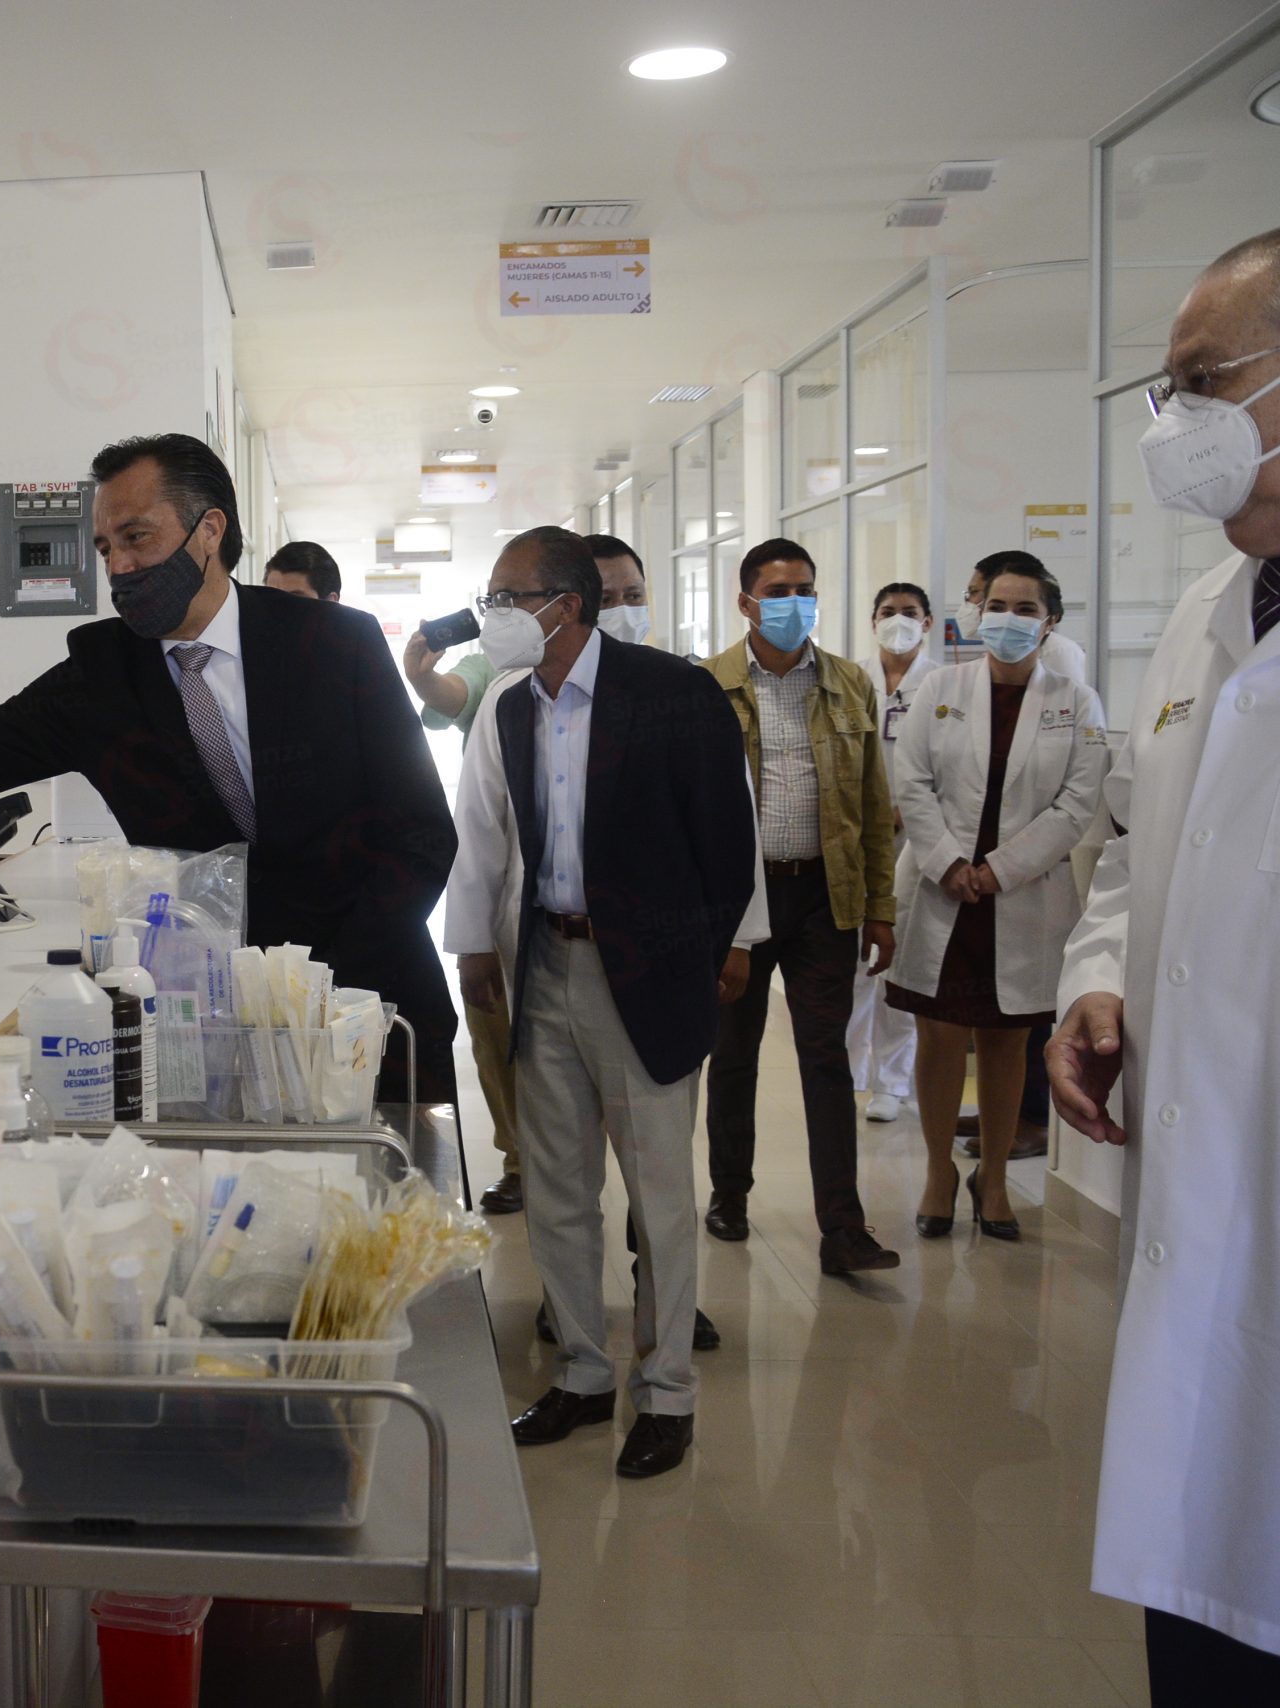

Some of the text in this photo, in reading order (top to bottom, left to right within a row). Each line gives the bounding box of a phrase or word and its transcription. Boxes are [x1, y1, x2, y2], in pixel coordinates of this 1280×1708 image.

[507, 262, 566, 271] ENCAMADOS
[507, 270, 612, 281] MUJERES (CAMAS 11-15)
[544, 292, 641, 303] AISLADO ADULTO 1
[15, 482, 77, 492] TAB “SVH”
[66, 1037, 114, 1057] PROTE
[67, 1066, 99, 1077] ALCOHOL
